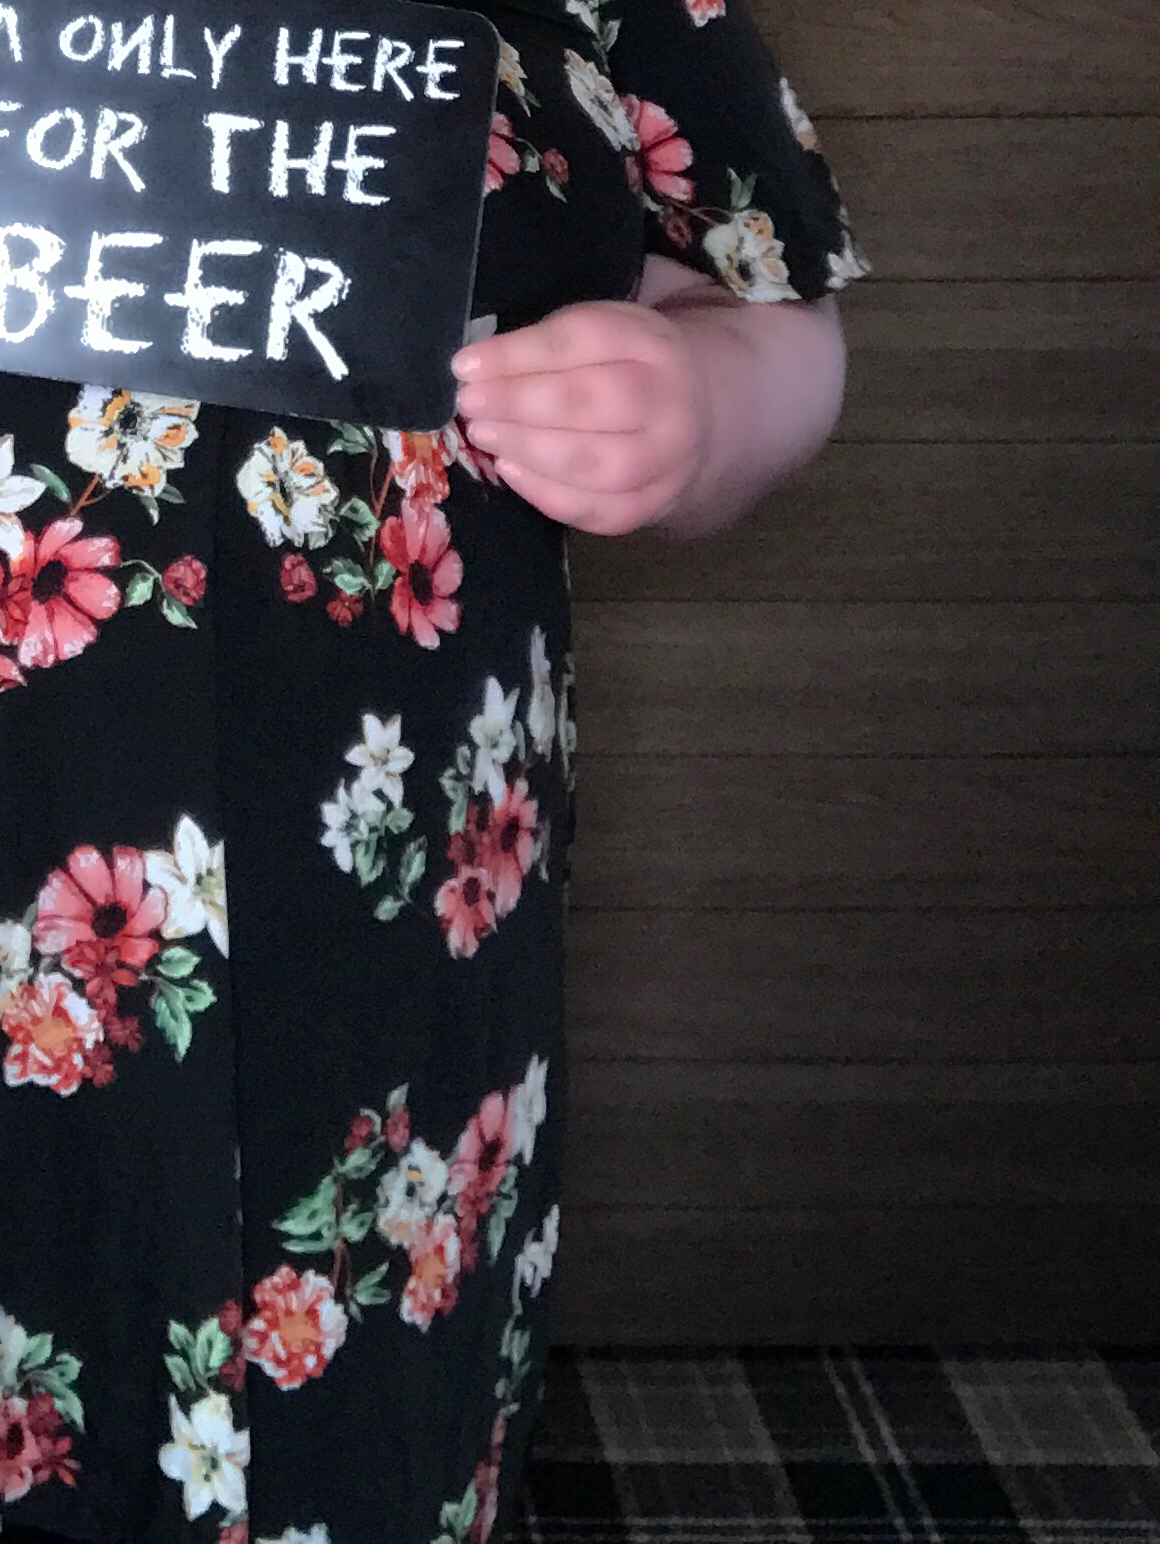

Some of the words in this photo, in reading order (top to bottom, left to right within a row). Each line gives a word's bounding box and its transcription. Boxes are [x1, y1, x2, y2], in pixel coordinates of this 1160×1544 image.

[59, 14, 240, 88] ONLY
[274, 27, 466, 102] HERE
[203, 112, 397, 206] THE
